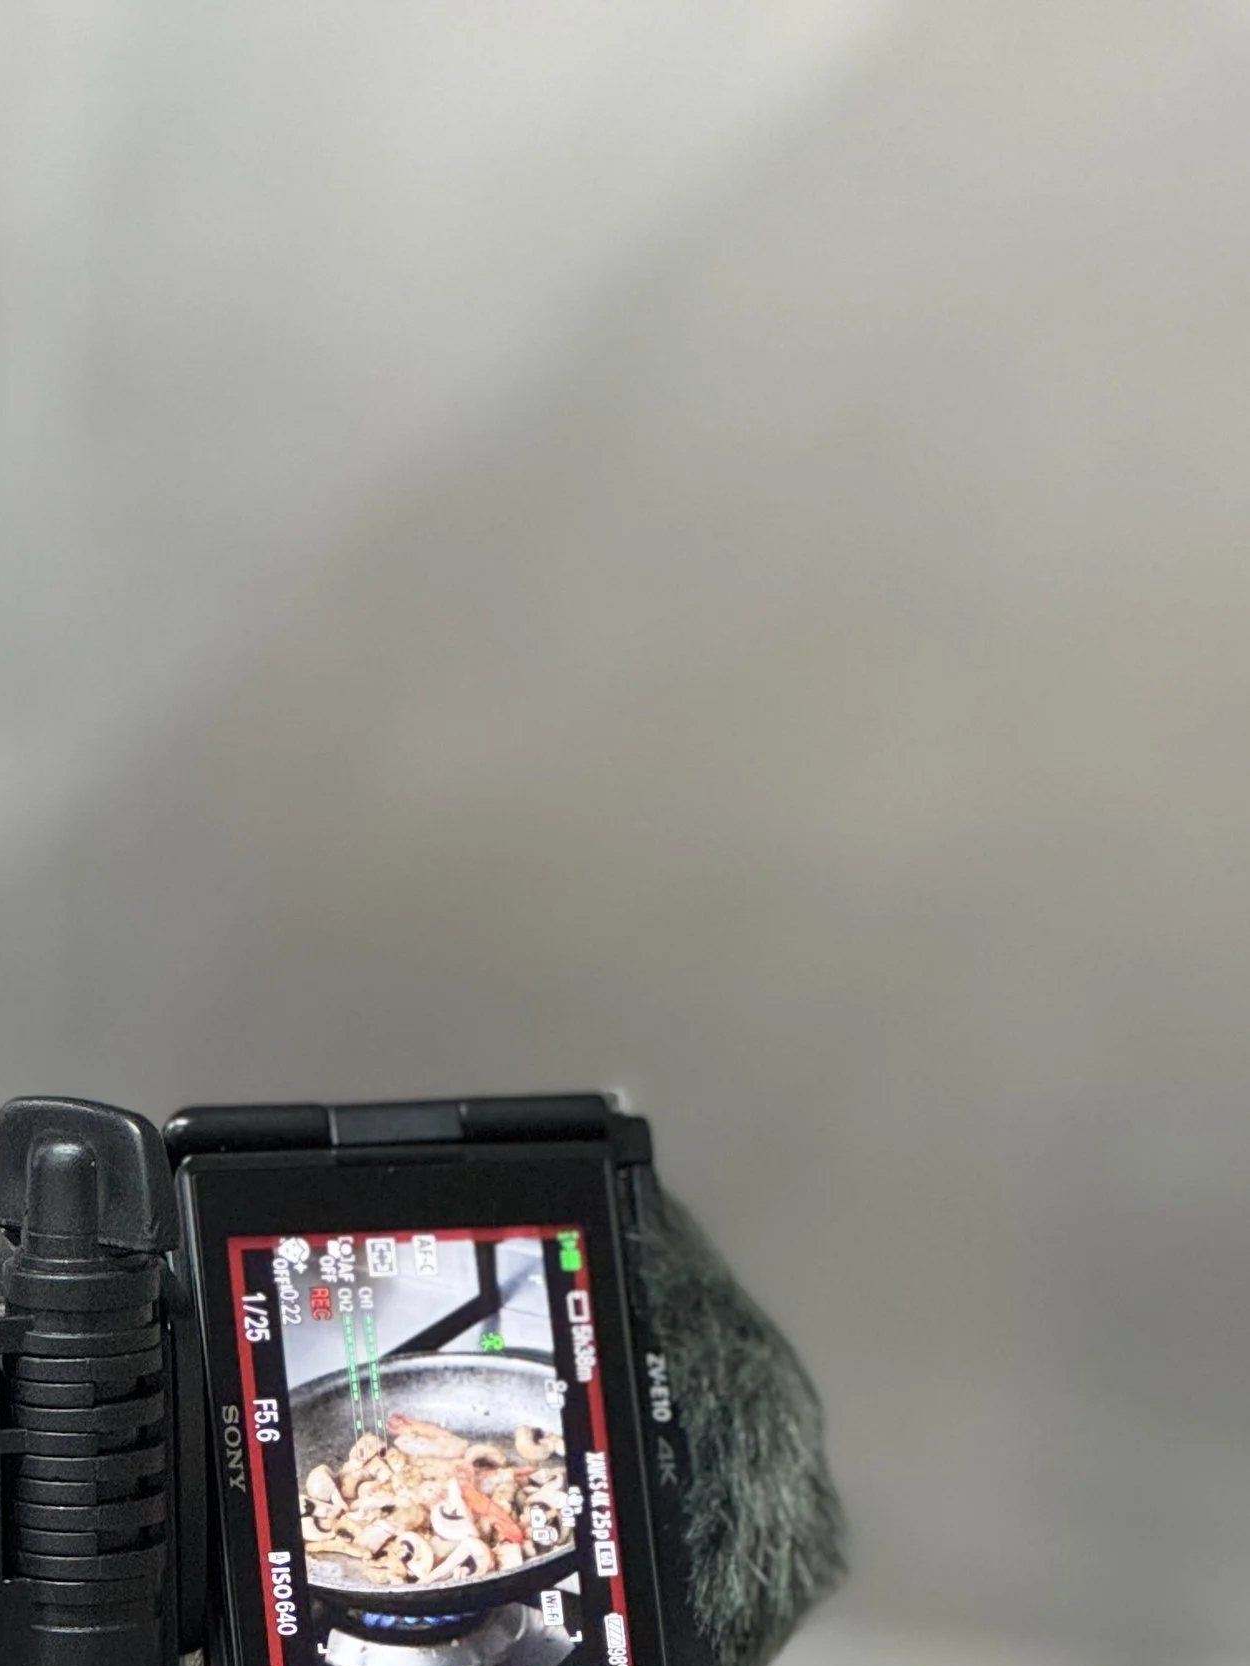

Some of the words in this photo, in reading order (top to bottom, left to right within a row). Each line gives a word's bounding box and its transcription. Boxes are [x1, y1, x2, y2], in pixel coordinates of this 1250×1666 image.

[272, 1258, 292, 1285] OFF
[319, 1255, 337, 1283] OFF
[416, 1239, 435, 1272] AF-C
[310, 1287, 332, 1321] REC
[338, 1287, 353, 1312] CH2
[358, 1286, 373, 1309] CH1
[241, 1292, 271, 1342] 1/25
[646, 1352, 673, 1423] ZV-E10
[253, 1399, 281, 1443] F5.6
[221, 1404, 247, 1494] SONY
[657, 1435, 679, 1487] 4K
[592, 1510, 612, 1541] 25p
[544, 1593, 561, 1624] Wi-Fi
